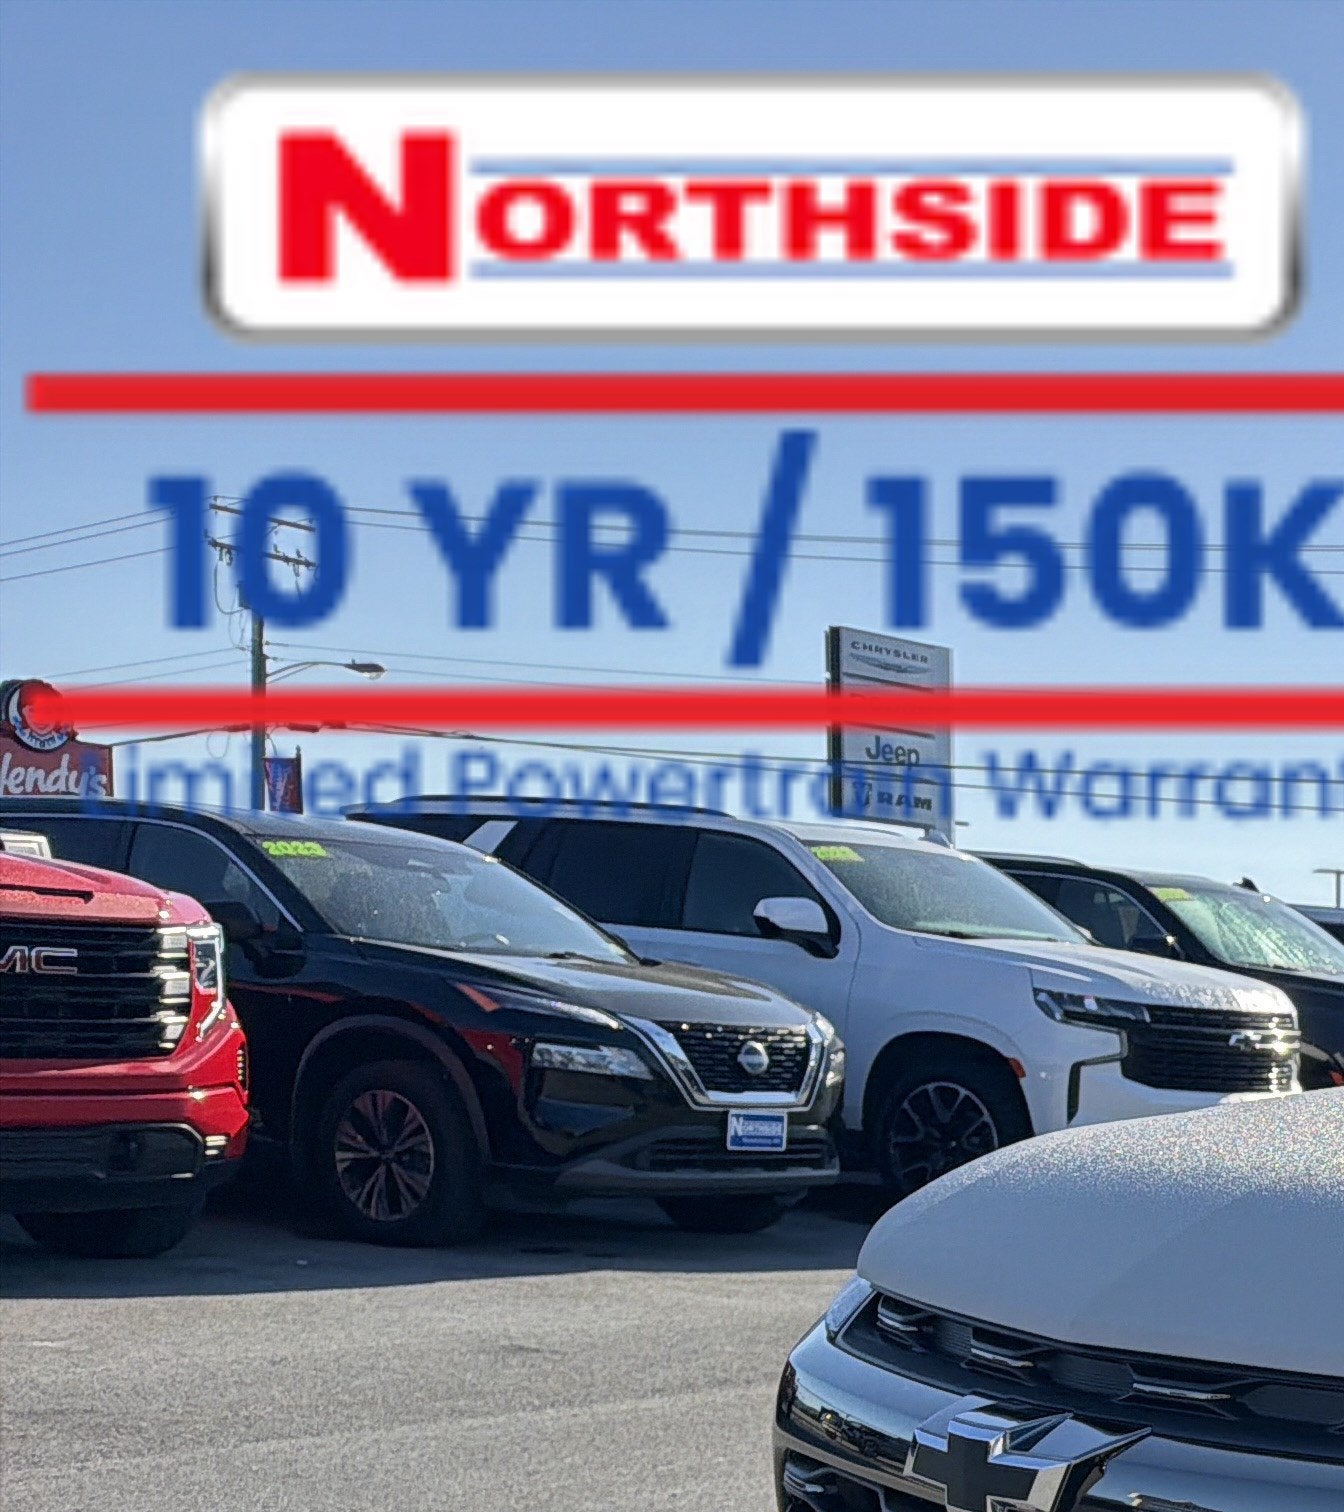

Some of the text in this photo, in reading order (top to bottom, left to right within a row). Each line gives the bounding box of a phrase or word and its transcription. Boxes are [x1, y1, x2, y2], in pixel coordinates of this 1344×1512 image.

[850, 640, 929, 664] CHRYSLER
[864, 735, 920, 766] Jeep
[0, 752, 108, 798] endy's
[0, 945, 79, 974] MC
